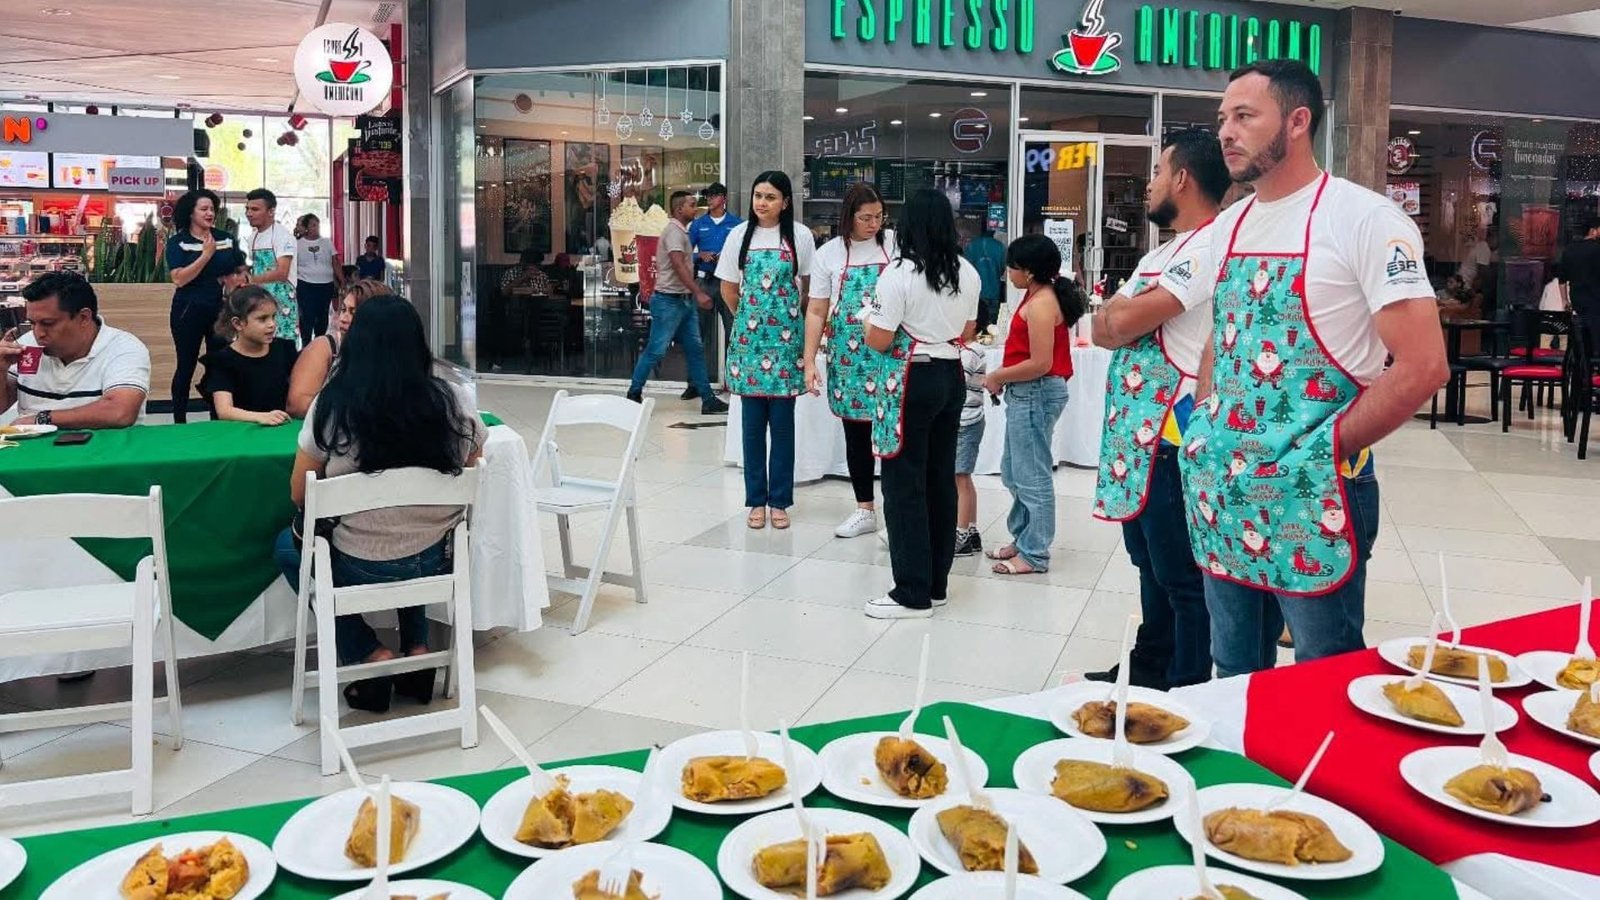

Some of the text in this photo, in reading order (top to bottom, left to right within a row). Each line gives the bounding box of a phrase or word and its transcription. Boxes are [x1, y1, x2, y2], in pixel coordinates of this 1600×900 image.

[831, 0, 1321, 77] ESPRESSO AMERICANO
[111, 176, 160, 186] PICK UP
